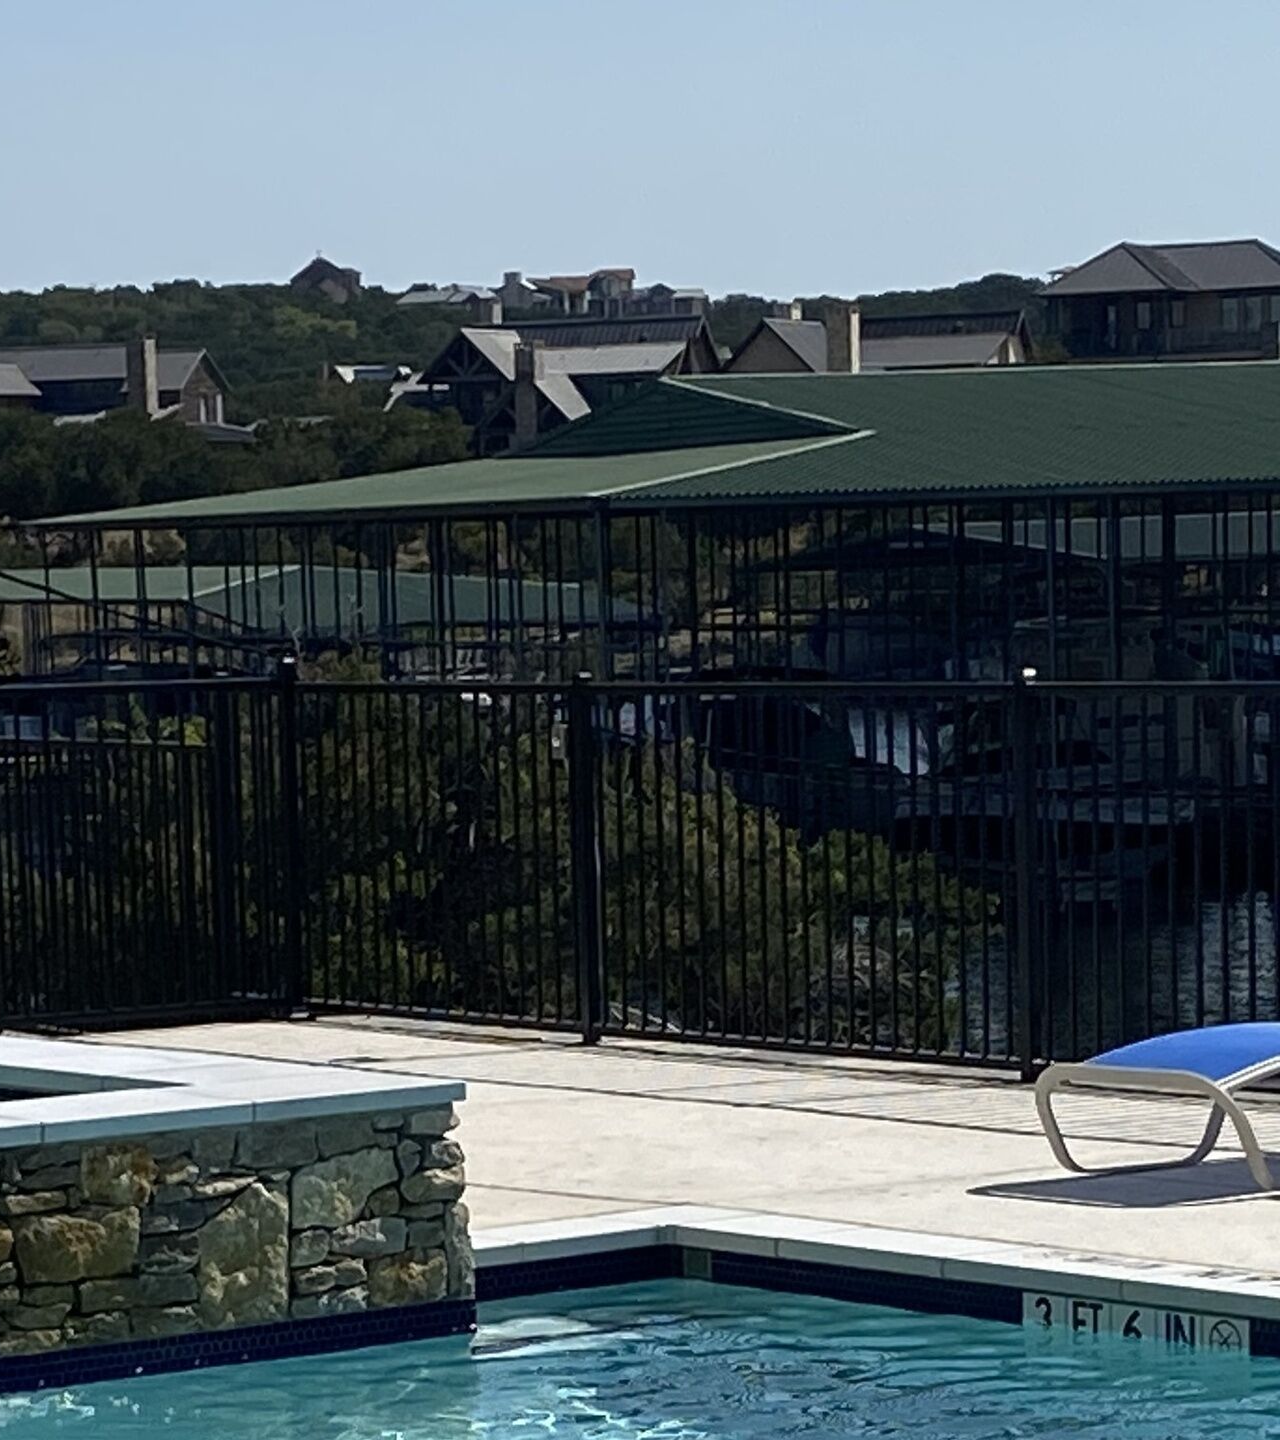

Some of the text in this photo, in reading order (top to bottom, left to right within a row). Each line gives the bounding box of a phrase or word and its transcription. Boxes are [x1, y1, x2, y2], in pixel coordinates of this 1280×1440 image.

[1035, 1297, 1053, 1327] 3
[1072, 1301, 1104, 1334] FT
[1165, 1313, 1196, 1347] IN
